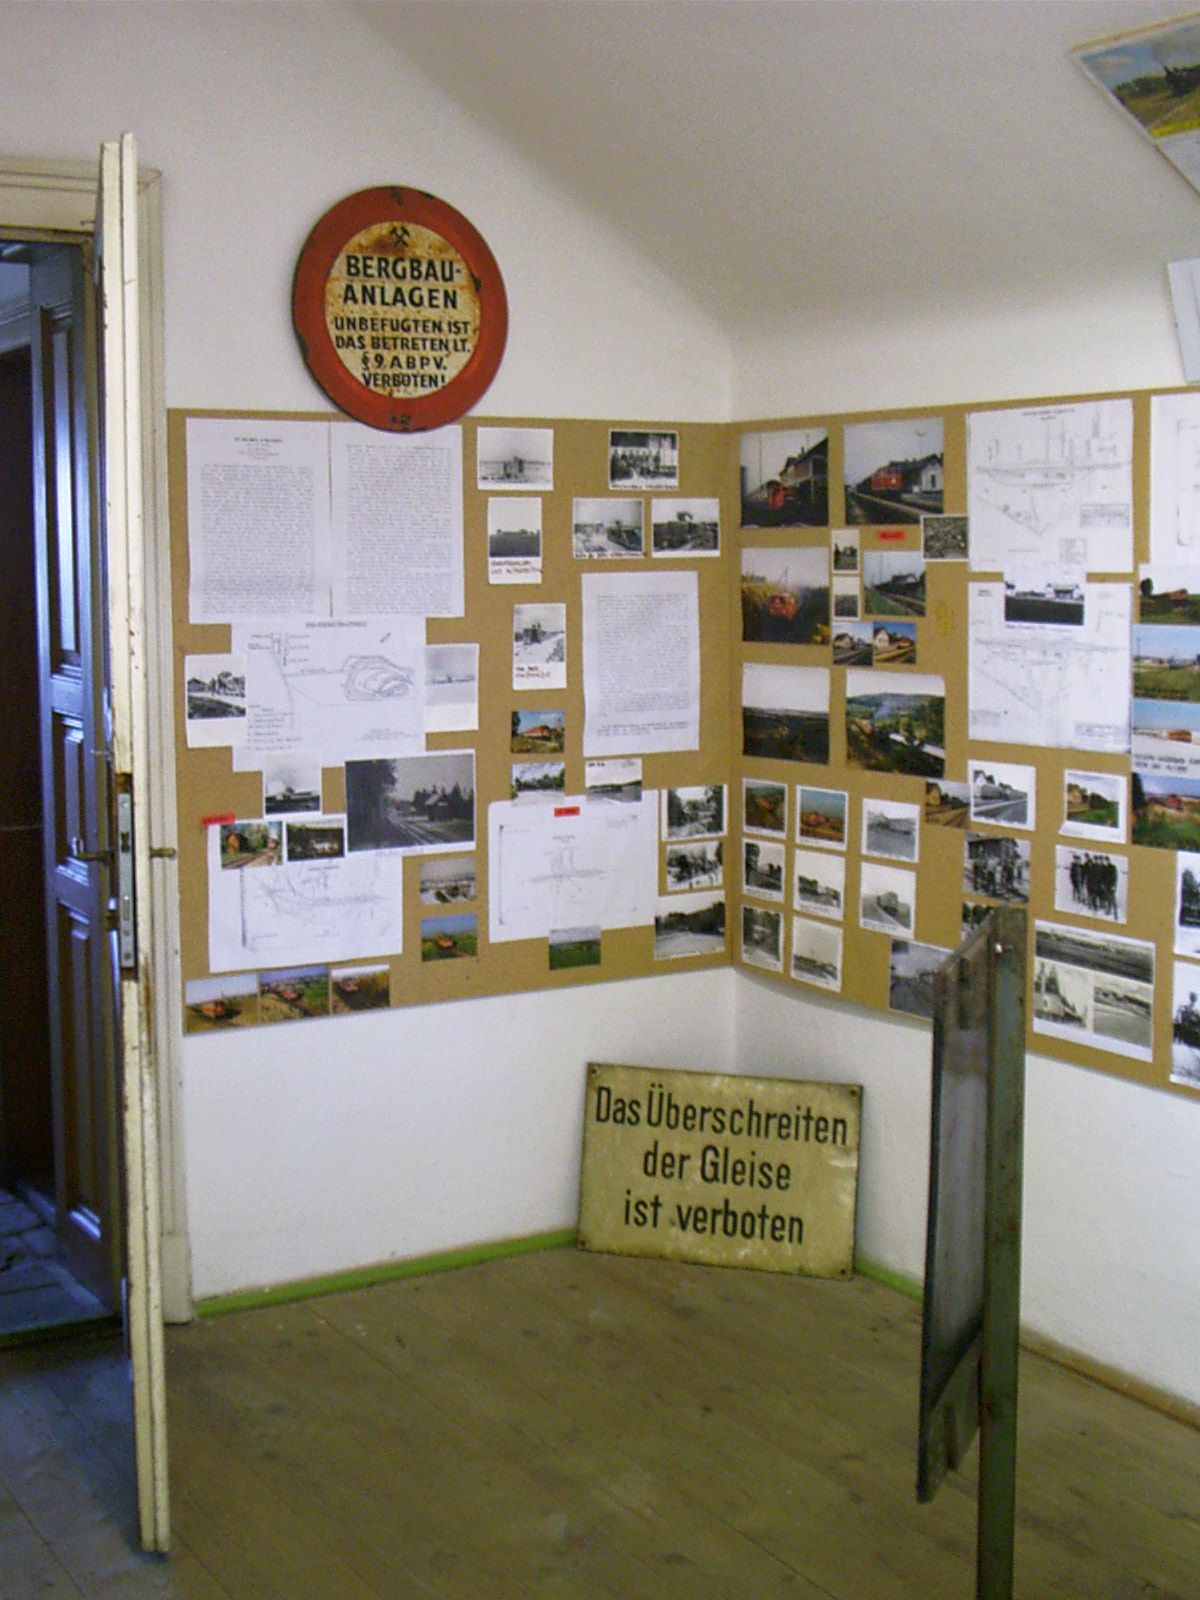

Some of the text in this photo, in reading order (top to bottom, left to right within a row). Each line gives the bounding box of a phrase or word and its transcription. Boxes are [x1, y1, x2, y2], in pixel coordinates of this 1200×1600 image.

[346, 254, 461, 282] BERGBAU-
[343, 285, 458, 309] ANLAGEN
[334, 317, 470, 334] UNBEFUGTEN IST
[335, 335, 366, 350] DAS
[371, 336, 448, 352] BETRETEN
[361, 352, 370, 371] §
[375, 354, 384, 368] 9
[361, 372, 446, 389] VERBOTEN!
[596, 1083, 847, 1146] Das Überschreiten
[643, 1141, 791, 1190] der Gleise
[624, 1190, 804, 1245] ist verboten
